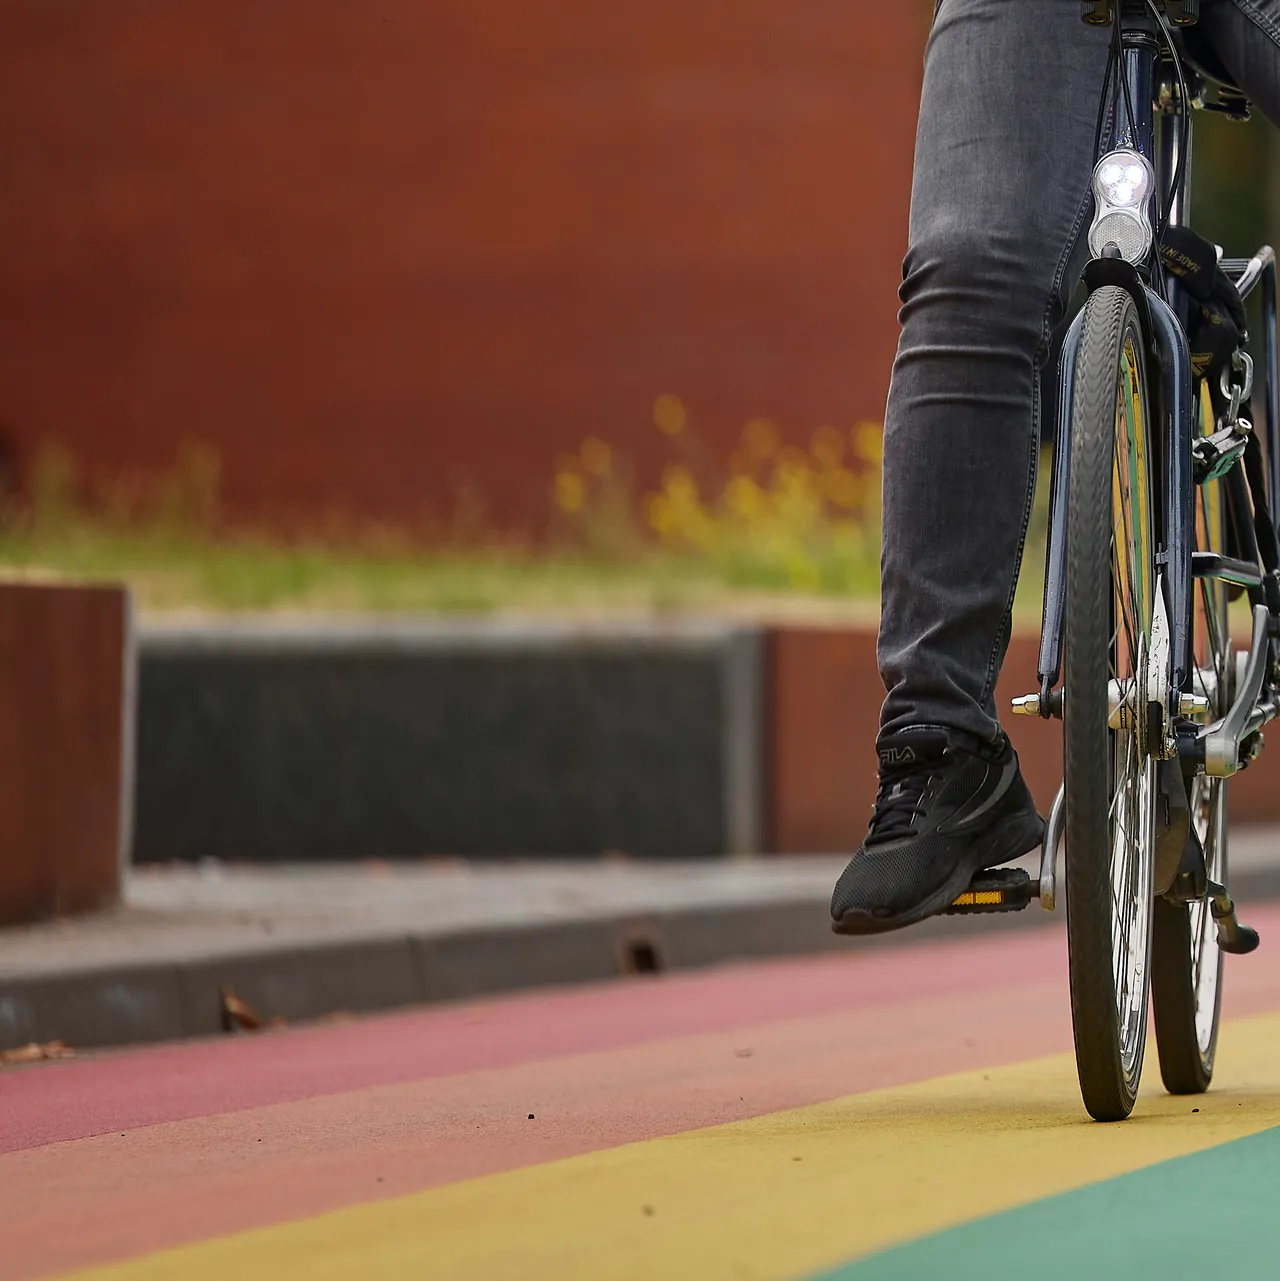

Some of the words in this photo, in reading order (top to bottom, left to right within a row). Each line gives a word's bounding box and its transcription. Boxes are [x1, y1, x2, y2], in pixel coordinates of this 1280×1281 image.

[1166, 246, 1180, 261] IN
[1176, 253, 1201, 274] MADE
[880, 746, 916, 764] FILA
